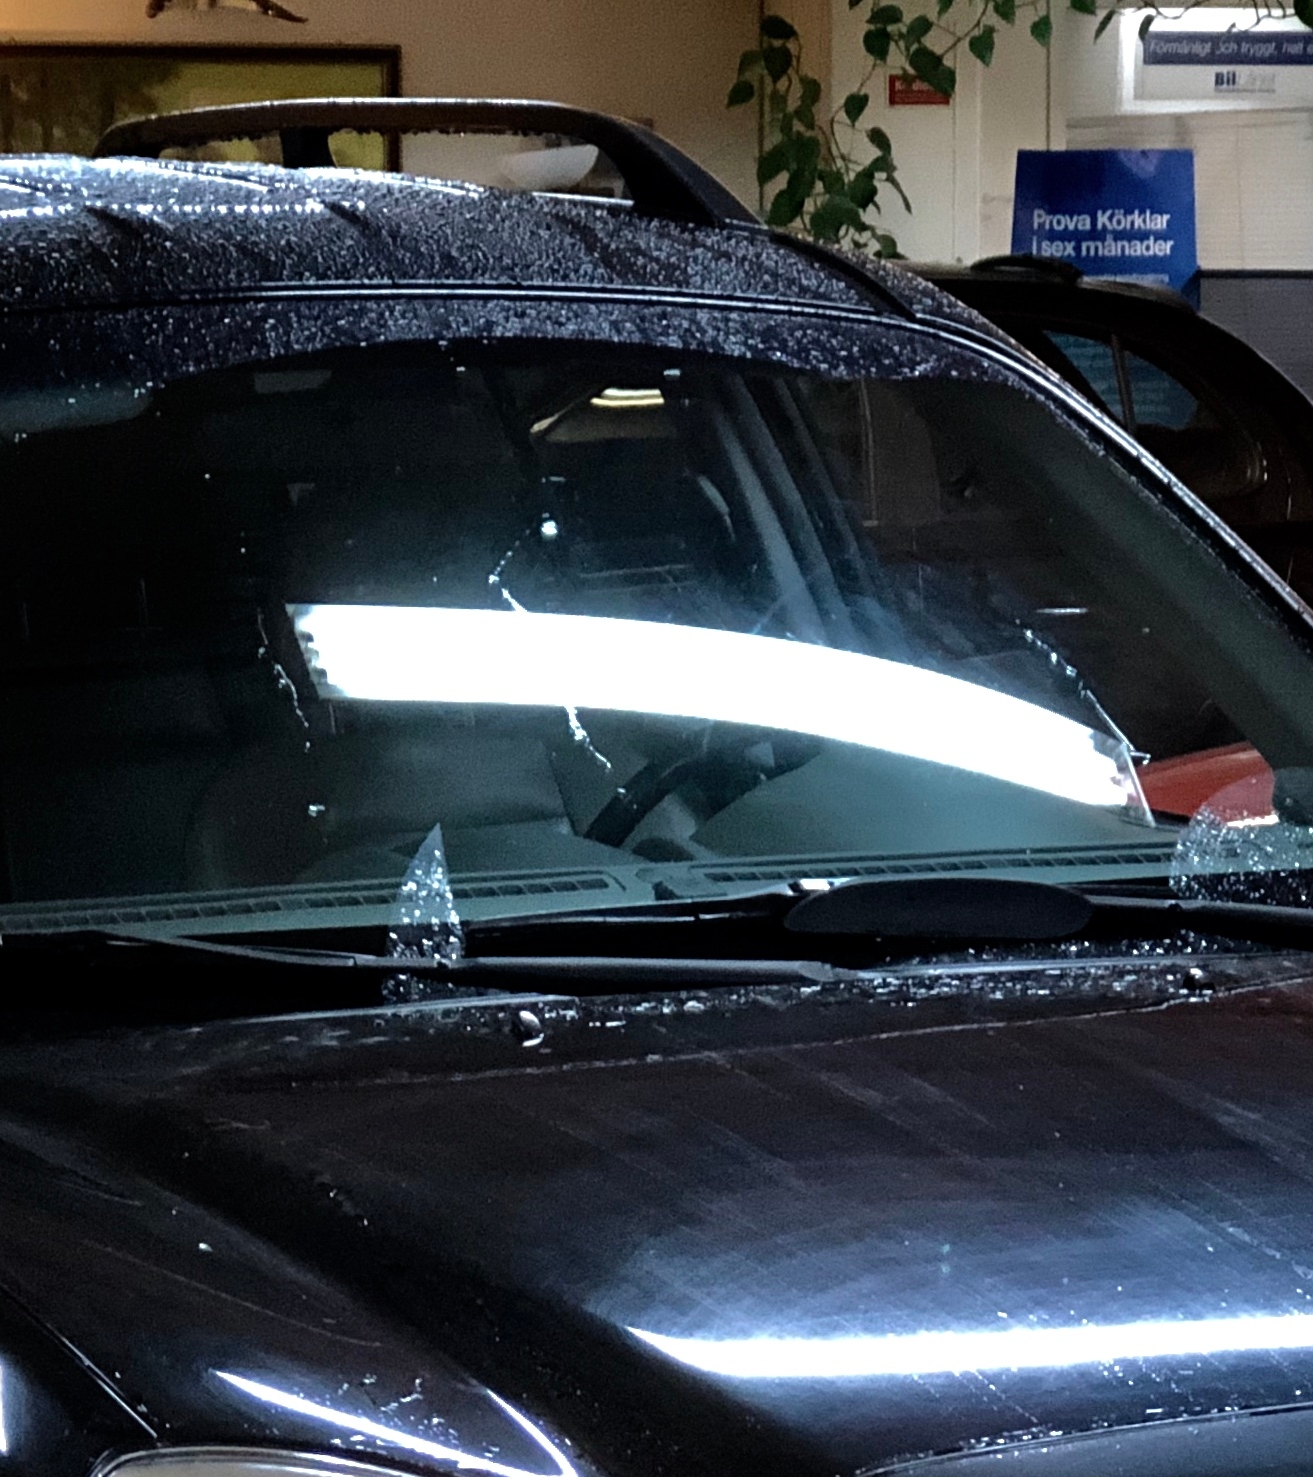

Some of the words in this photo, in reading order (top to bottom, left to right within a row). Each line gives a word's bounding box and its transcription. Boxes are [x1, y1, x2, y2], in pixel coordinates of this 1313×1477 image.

[1150, 39, 1213, 57] Förmånligt
[1033, 209, 1091, 231] Prova
[1097, 209, 1171, 231] Körklar
[1041, 240, 1076, 257] sex
[1081, 234, 1175, 257] månader
